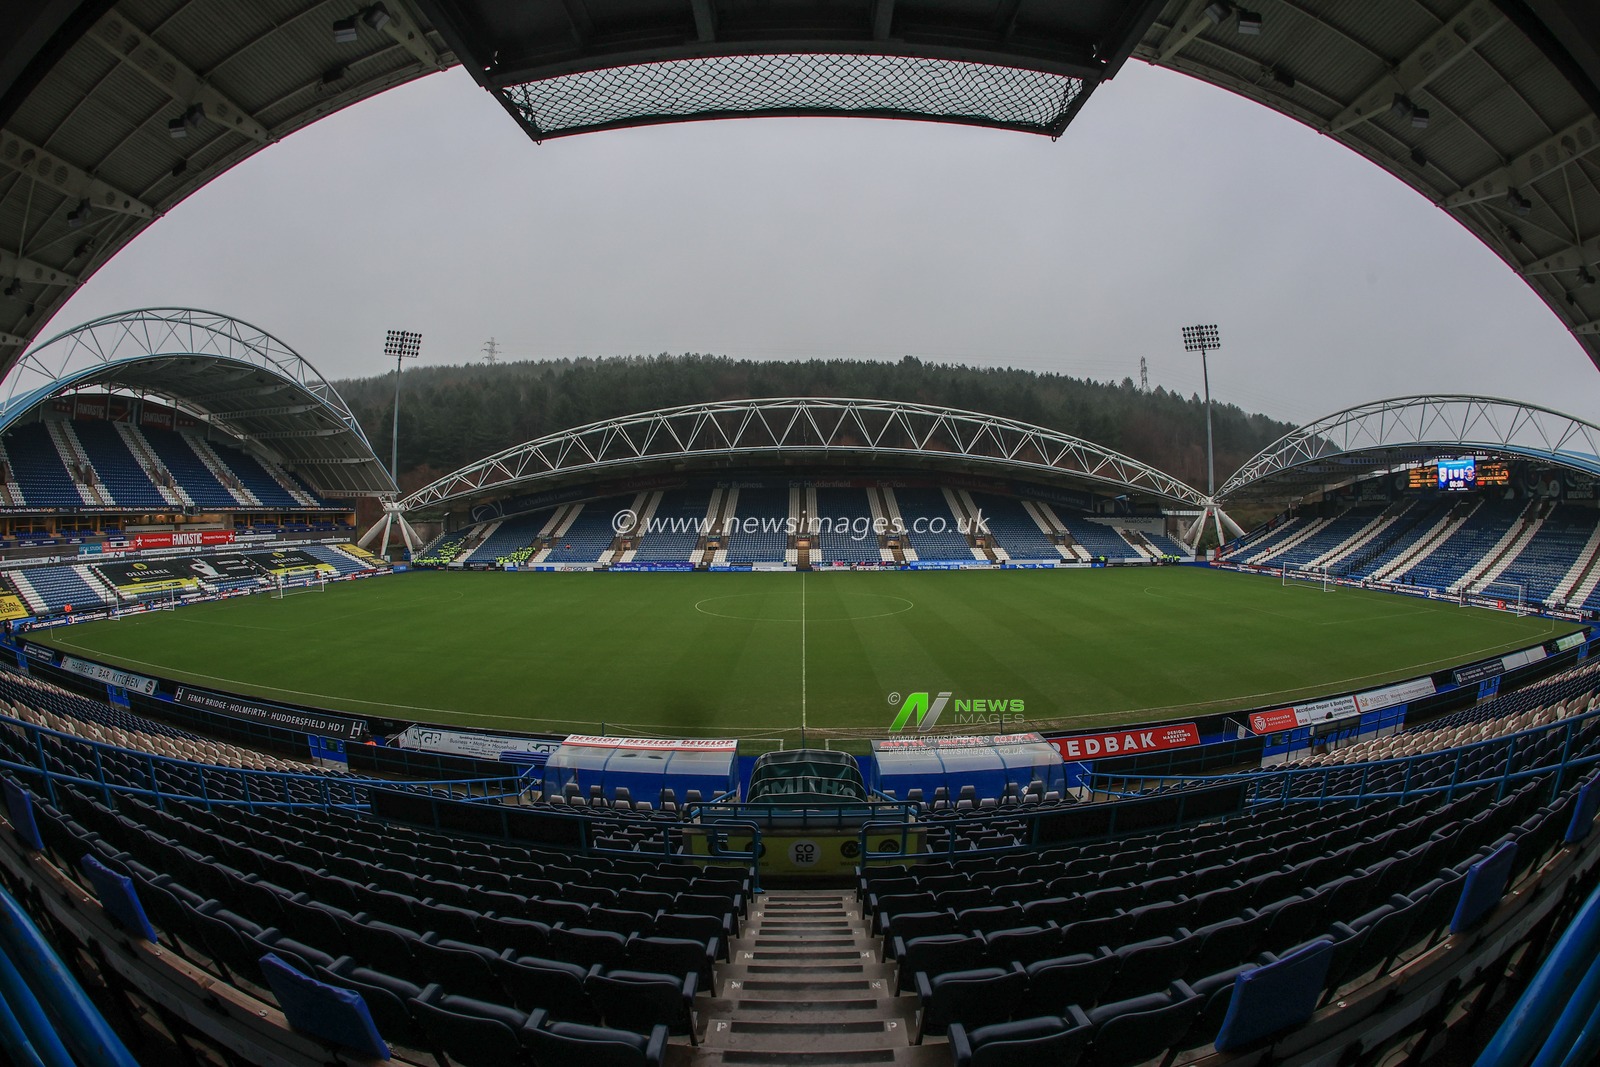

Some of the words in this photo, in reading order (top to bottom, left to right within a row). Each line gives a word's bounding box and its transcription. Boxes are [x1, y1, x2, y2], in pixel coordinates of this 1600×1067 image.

[172, 532, 203, 546] FANTASTIC
[97, 669, 110, 680] BAR
[111, 672, 141, 689] KITCHEN
[1296, 705, 1315, 714] Accident
[1315, 703, 1330, 711] Repair
[1334, 698, 1353, 708] Bodyshop
[187, 693, 205, 704] FENAY
[205, 696, 226, 710] BRIDGE
[229, 703, 267, 718] HOLMFIRTH
[270, 711, 326, 729] HUDDERSFIELD
[327, 721, 345, 733] HD1
[1162, 732, 1191, 742] MARKETING
[1166, 729, 1185, 737] DESIGN
[570, 735, 620, 744] DEVELOP
[624, 738, 677, 746] DEVELOP
[1169, 737, 1187, 746] BRAND
[491, 743, 518, 751] Household
